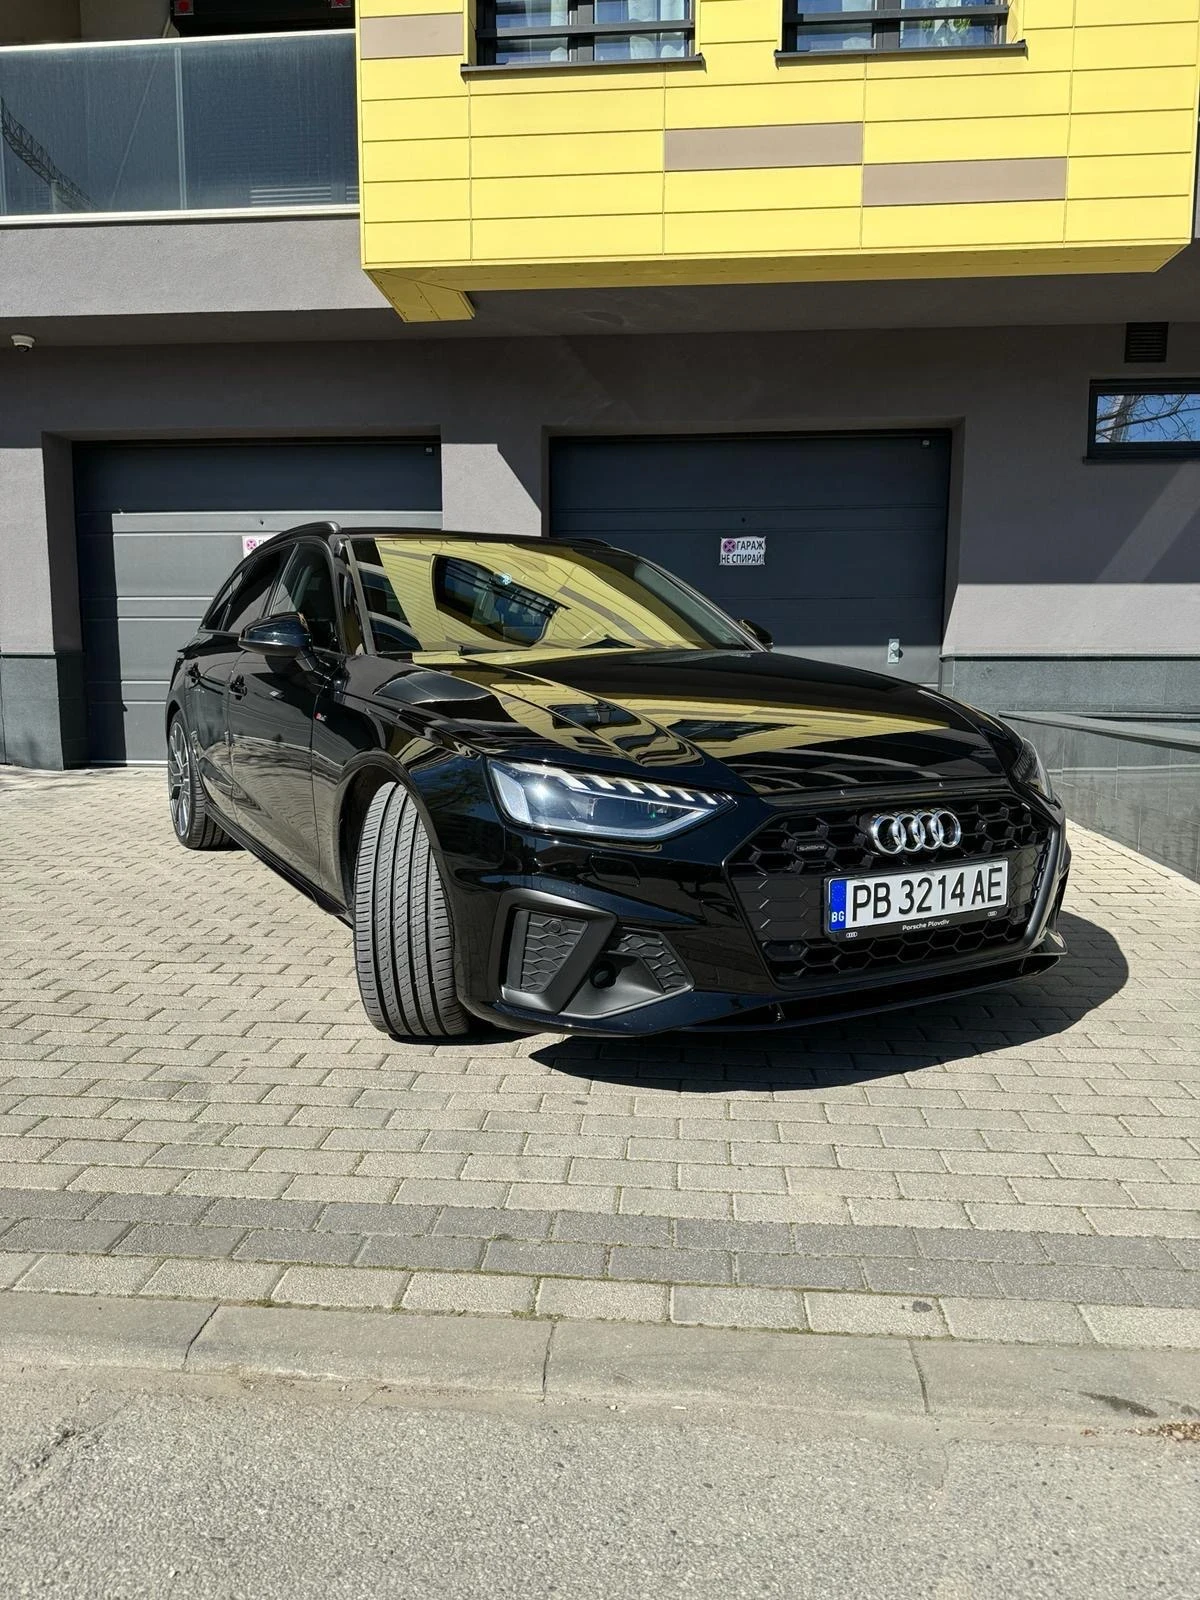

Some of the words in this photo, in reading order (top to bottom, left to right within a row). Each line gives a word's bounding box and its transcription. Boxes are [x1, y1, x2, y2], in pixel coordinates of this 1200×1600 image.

[736, 540, 764, 550] ГАРАЖ
[721, 554, 730, 563] НЕ
[731, 552, 764, 563] СПИРАЙ!
[852, 882, 891, 922] PB
[898, 872, 965, 915] 3214
[971, 867, 1003, 905] AE
[831, 911, 845, 923] BG
[902, 922, 927, 931] Porsche
[927, 919, 950, 929] Plovdiv
